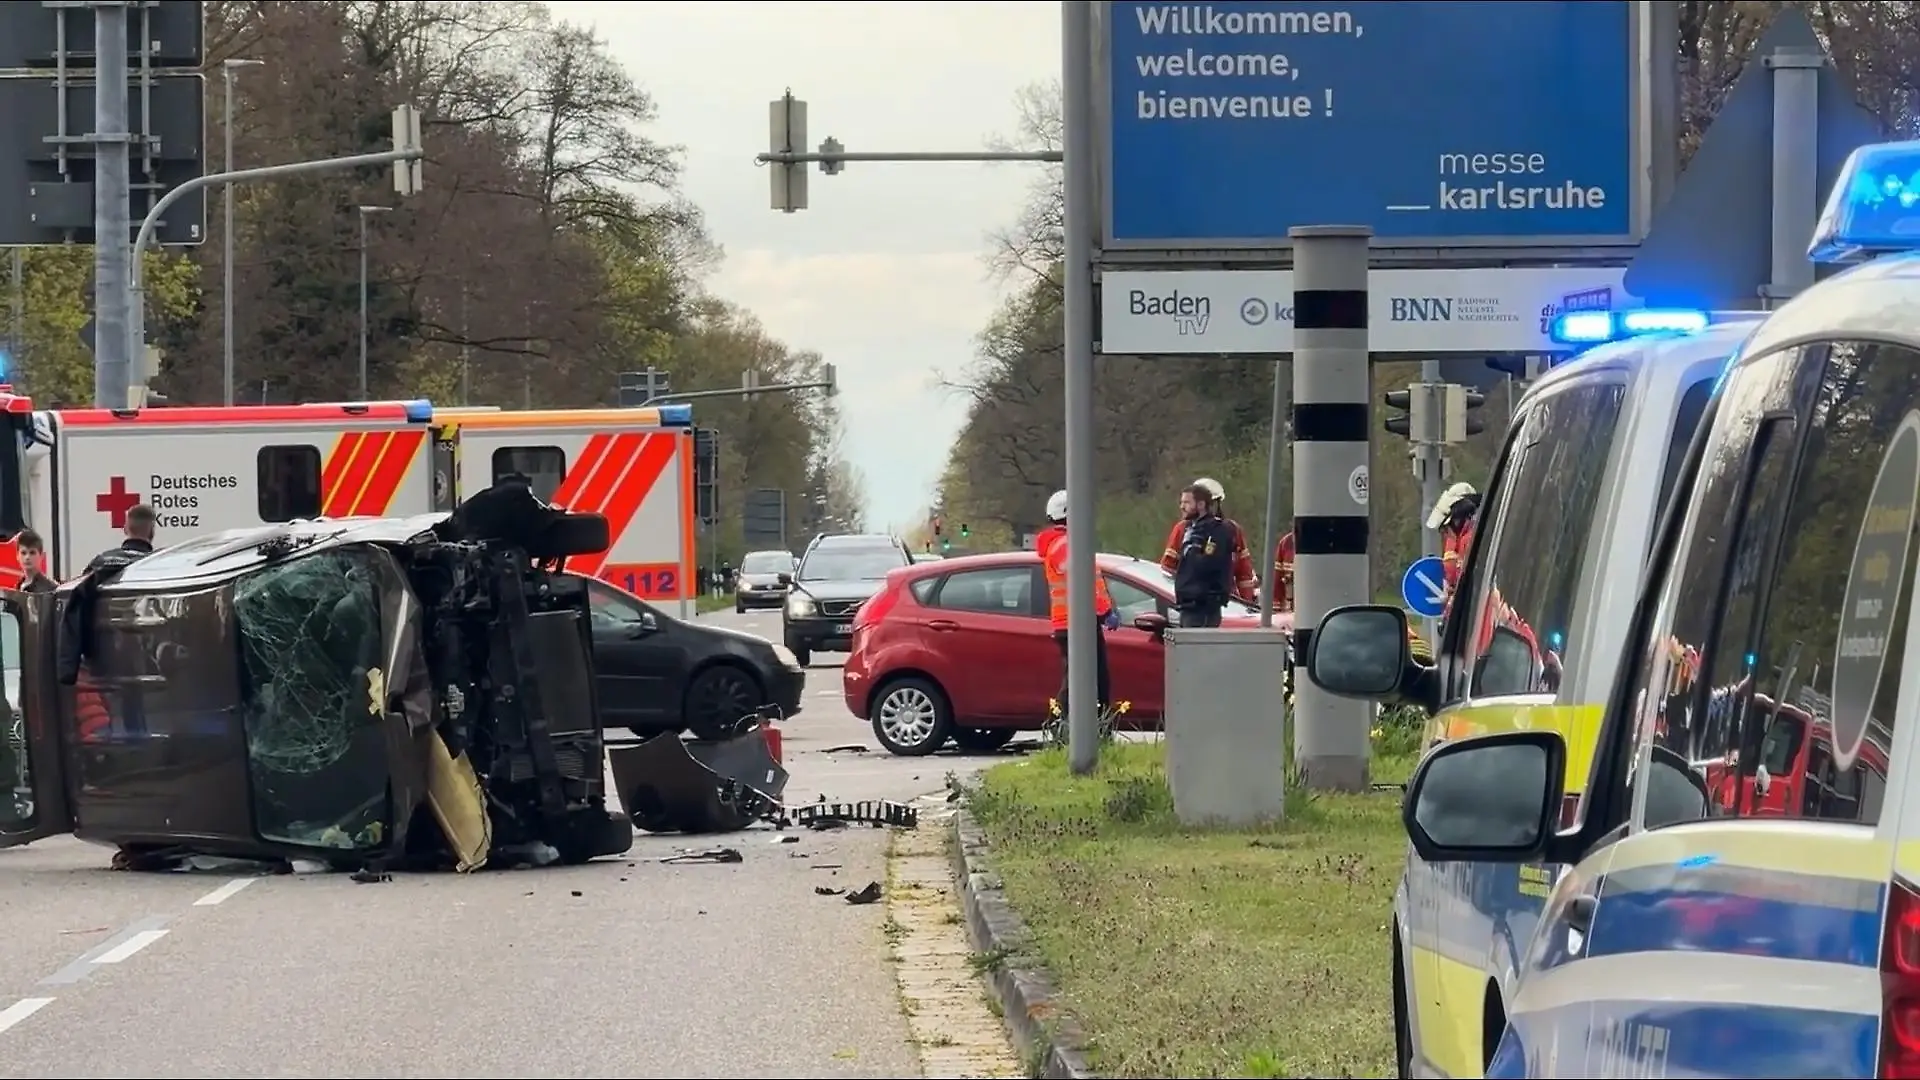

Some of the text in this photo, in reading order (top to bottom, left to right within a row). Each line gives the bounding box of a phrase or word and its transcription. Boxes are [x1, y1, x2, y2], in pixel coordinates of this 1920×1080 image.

[1136, 6, 1364, 38] Willkommen,
[1136, 48, 1299, 81] welcome,
[1138, 90, 1312, 118] bienvenue
[1439, 153, 1545, 174] messe
[1440, 180, 1605, 209] karlsruhe
[1130, 289, 1210, 315] Baden
[1390, 298, 1453, 321] BNN
[1175, 314, 1210, 335] TV
[151, 474, 237, 489] Deutsches
[151, 494, 198, 508] Rotes
[155, 513, 199, 527] Kreuz
[624, 571, 675, 593] 112
